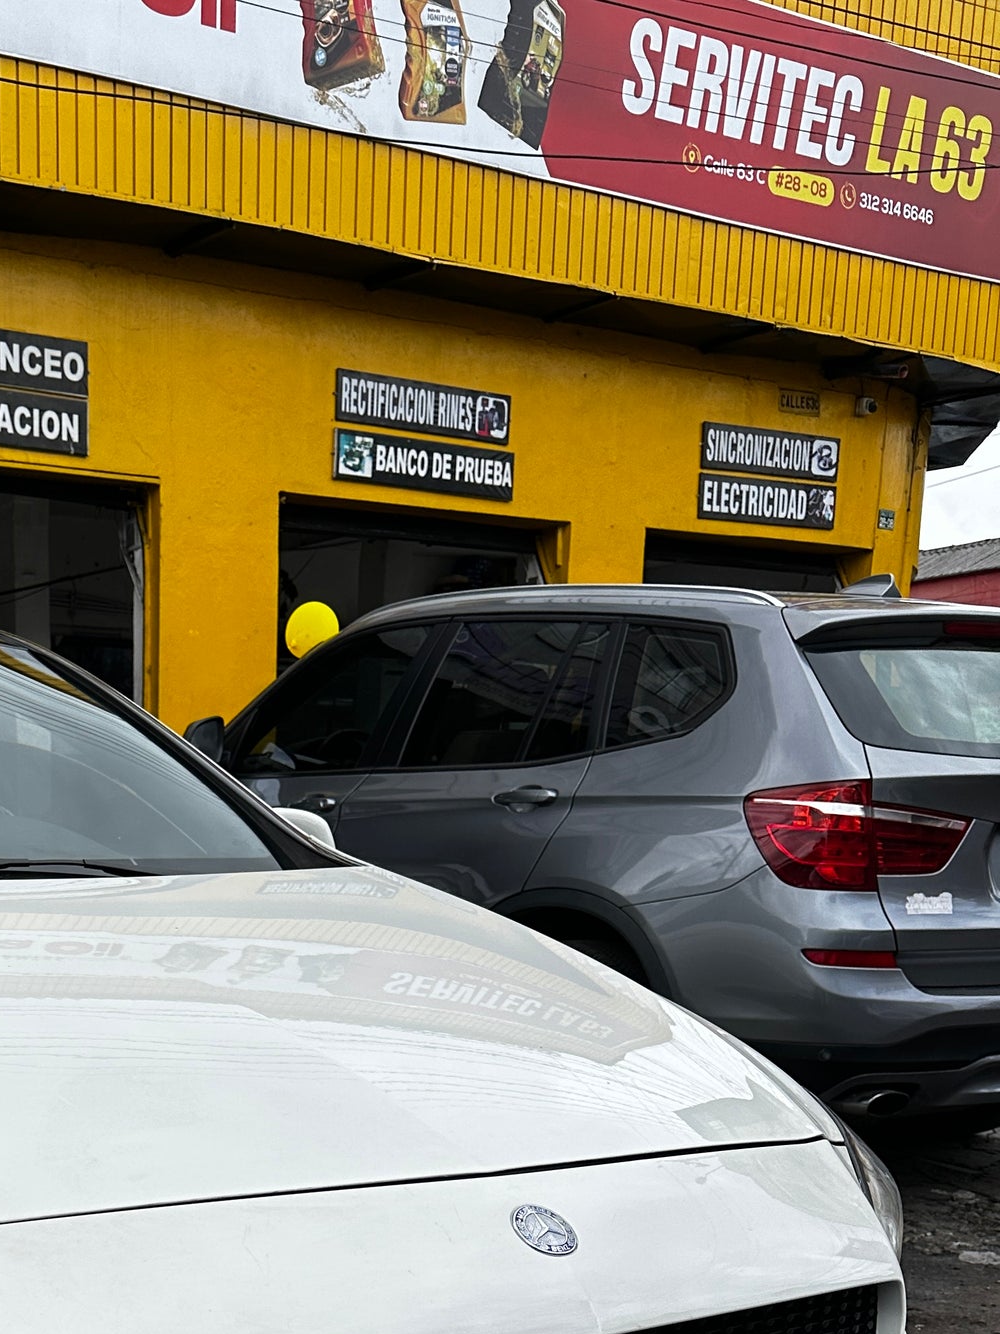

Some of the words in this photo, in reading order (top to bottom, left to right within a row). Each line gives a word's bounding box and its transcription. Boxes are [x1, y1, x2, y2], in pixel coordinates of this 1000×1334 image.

[622, 17, 864, 167] SERVITEC
[865, 86, 928, 184] LA
[930, 105, 993, 201] 63
[704, 154, 735, 178] Calle
[736, 162, 754, 182] 63
[756, 169, 766, 185] C
[775, 171, 800, 192] #28
[810, 180, 828, 198] 08
[859, 192, 880, 208] 312
[881, 197, 901, 216] 314
[903, 203, 934, 225] 6646
[341, 375, 436, 425] RECTIFICACION
[438, 393, 474, 431] RINES
[375, 444, 428, 478] BANCO
[431, 451, 453, 480] DE
[455, 454, 512, 487] PRUEBA
[706, 429, 811, 472] SINCRONIZACION
[703, 480, 807, 520] ELECTRICIDAD
